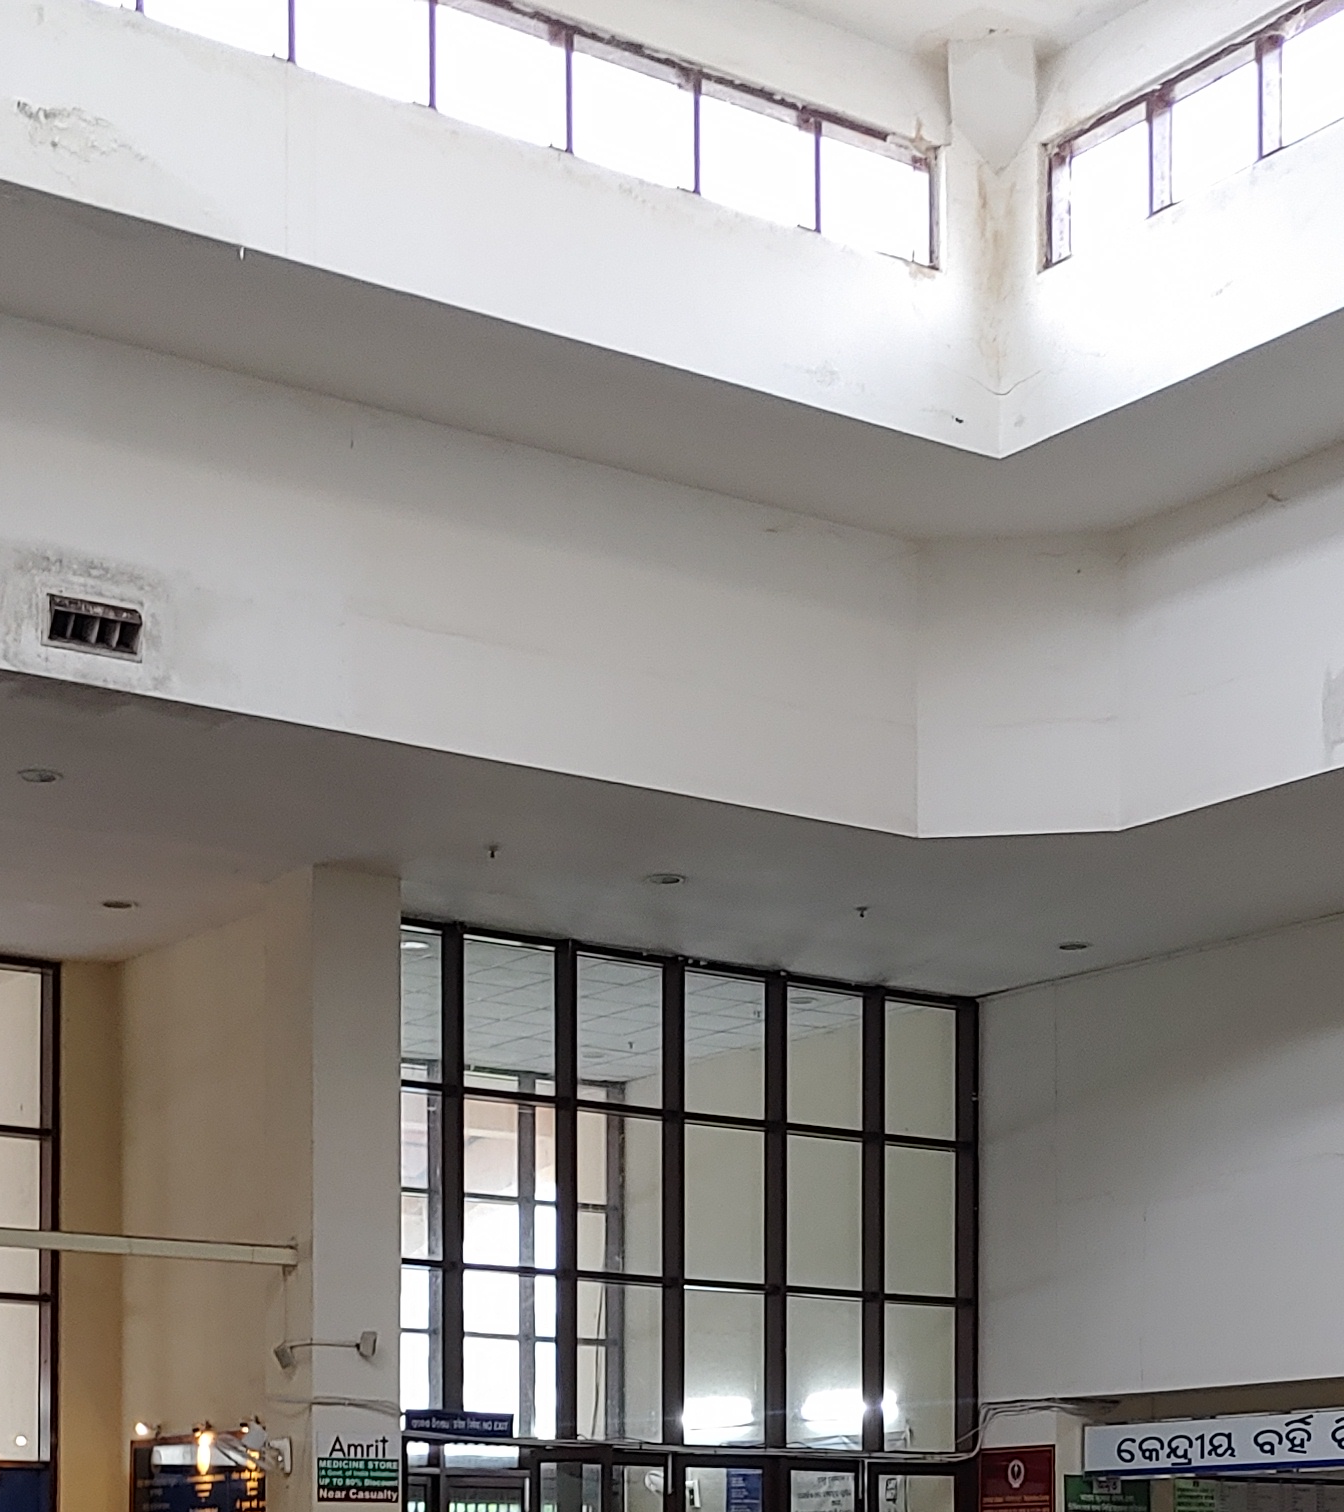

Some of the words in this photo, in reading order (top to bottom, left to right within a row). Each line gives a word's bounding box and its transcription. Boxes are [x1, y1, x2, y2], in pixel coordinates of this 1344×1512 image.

[329, 1435, 389, 1458] Amrit
[319, 1460, 365, 1469] MEDICINE
[367, 1461, 398, 1470] STORE
[319, 1477, 330, 1486] UP
[332, 1478, 343, 1486] TO
[319, 1488, 347, 1499] Near
[348, 1488, 398, 1501] Casualty
